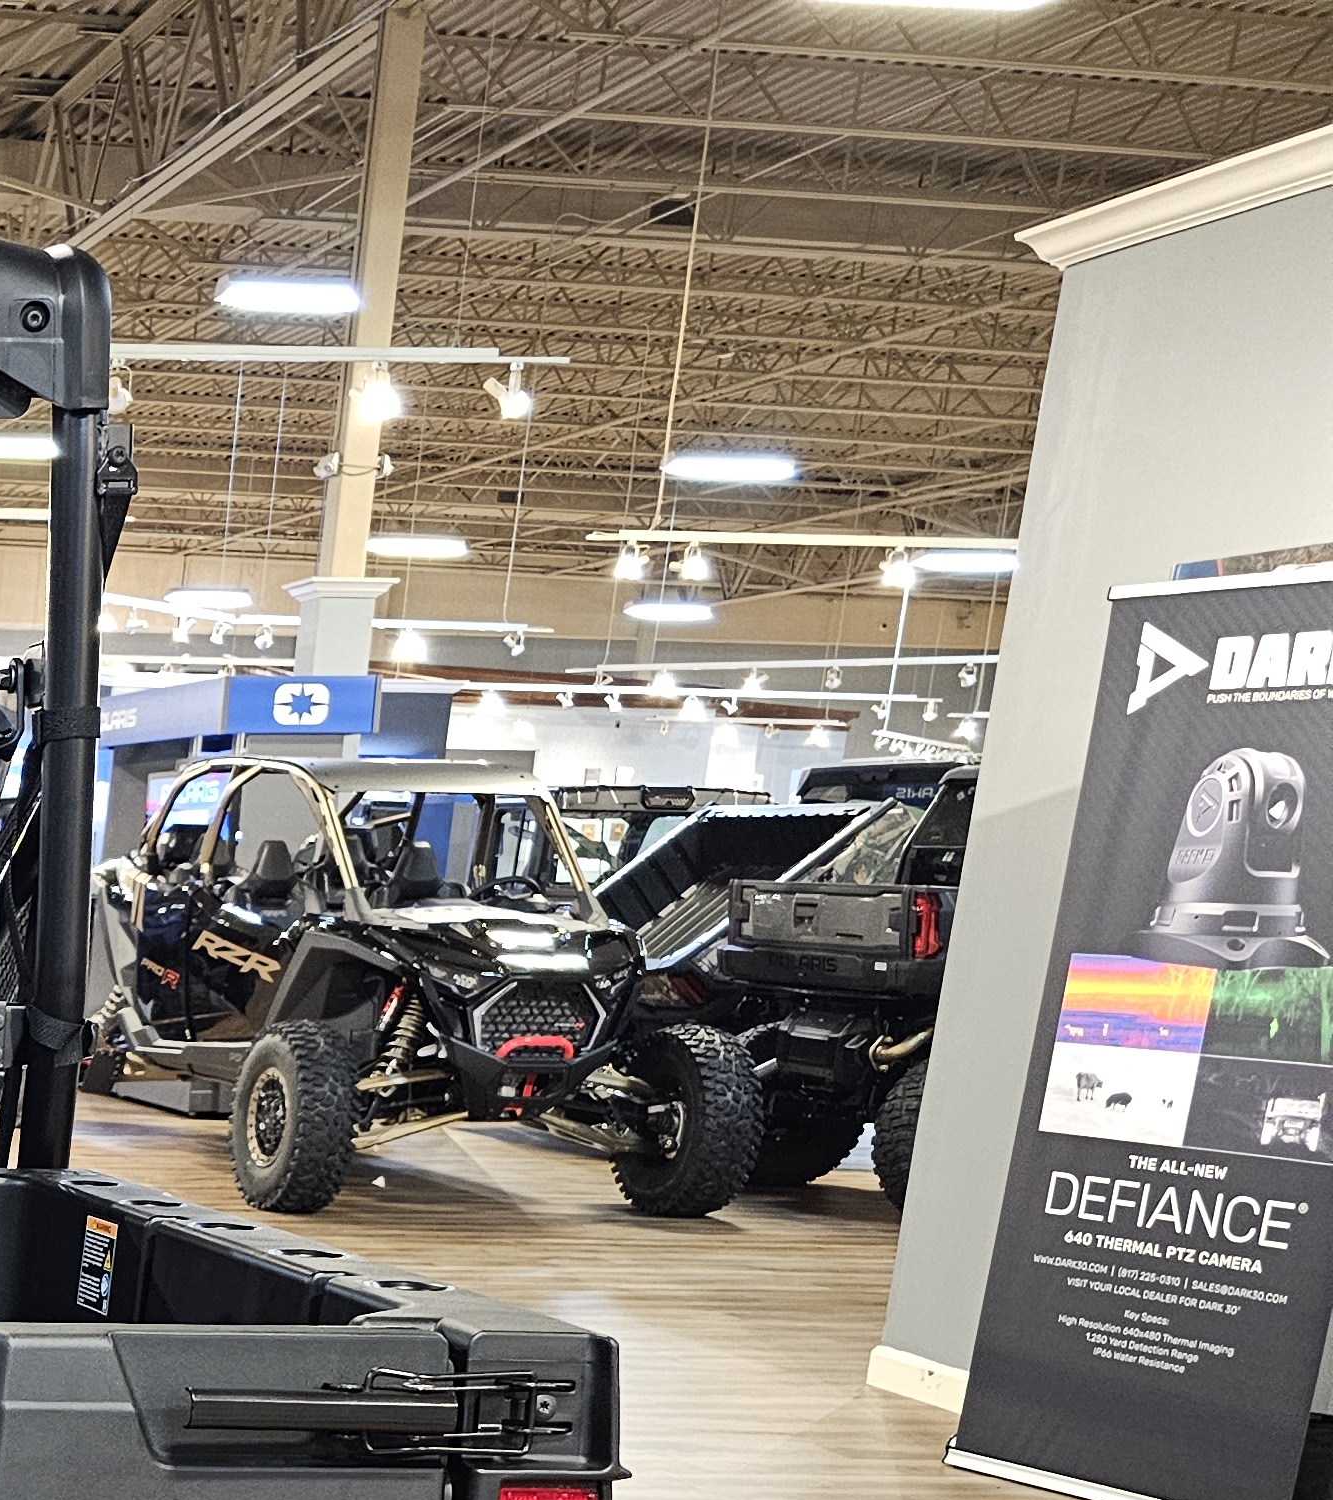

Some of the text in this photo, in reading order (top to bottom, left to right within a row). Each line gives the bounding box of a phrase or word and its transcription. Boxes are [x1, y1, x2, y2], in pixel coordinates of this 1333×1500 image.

[1209, 630, 1333, 690] DAR
[1206, 689, 1327, 704] PUSH THE BOUNDARIES OF
[191, 929, 282, 984] RZR
[1128, 1154, 1229, 1180] THE ALL-NEW
[1064, 1229, 1263, 1274] 640 THERMAL PTZ CAMERA
[1067, 1277, 1088, 1288] VISIT
[1089, 1280, 1113, 1293] YOUR
[1113, 1284, 1142, 1299] LOCAL
[1143, 1289, 1178, 1305] DEALER
[1179, 1295, 1198, 1308] FOR
[1198, 1299, 1224, 1313] DARK
[1123, 1309, 1140, 1322] Key
[1058, 1313, 1235, 1358] High Resolution 640x480 Thermal Imaging
[1109, 1336, 1129, 1349] Yard
[1129, 1340, 1170, 1357] Detection
[1170, 1348, 1200, 1364] Range
[1092, 1346, 1186, 1374] IP66 Water Resistance
